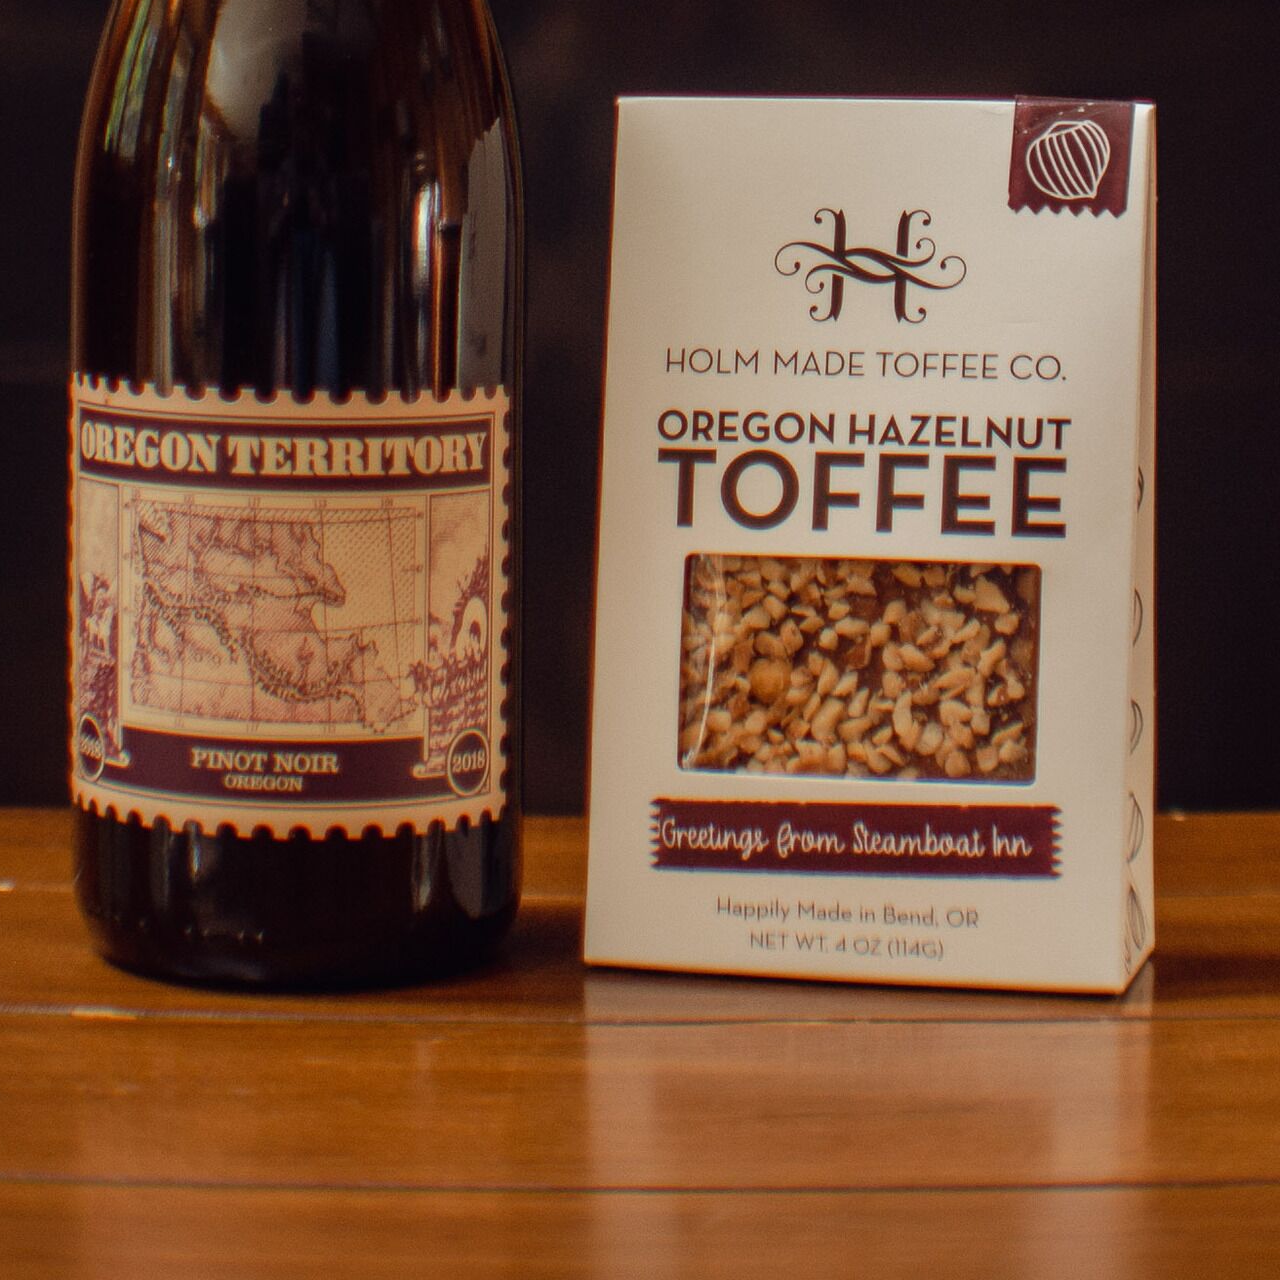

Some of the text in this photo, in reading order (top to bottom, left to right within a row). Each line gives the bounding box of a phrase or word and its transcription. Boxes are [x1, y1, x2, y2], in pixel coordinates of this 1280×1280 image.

[665, 347, 1068, 382] HOLM MADE TOFFEE CO.
[657, 409, 1072, 451] OREGON HAZELNUT
[80, 422, 487, 477] OREGON TERRITORY
[657, 446, 1068, 539] TOFFEE
[191, 747, 340, 773] PINOT NOIR
[452, 748, 486, 773] 2018
[224, 774, 304, 792] OREGON
[661, 816, 1034, 861] Greetings from Steamboat Inn
[716, 895, 791, 922] Happily
[797, 899, 853, 921] Made
[858, 903, 876, 923] in
[946, 907, 980, 929] OR
[749, 931, 946, 962] NET WT. 4 OZ (114G)
